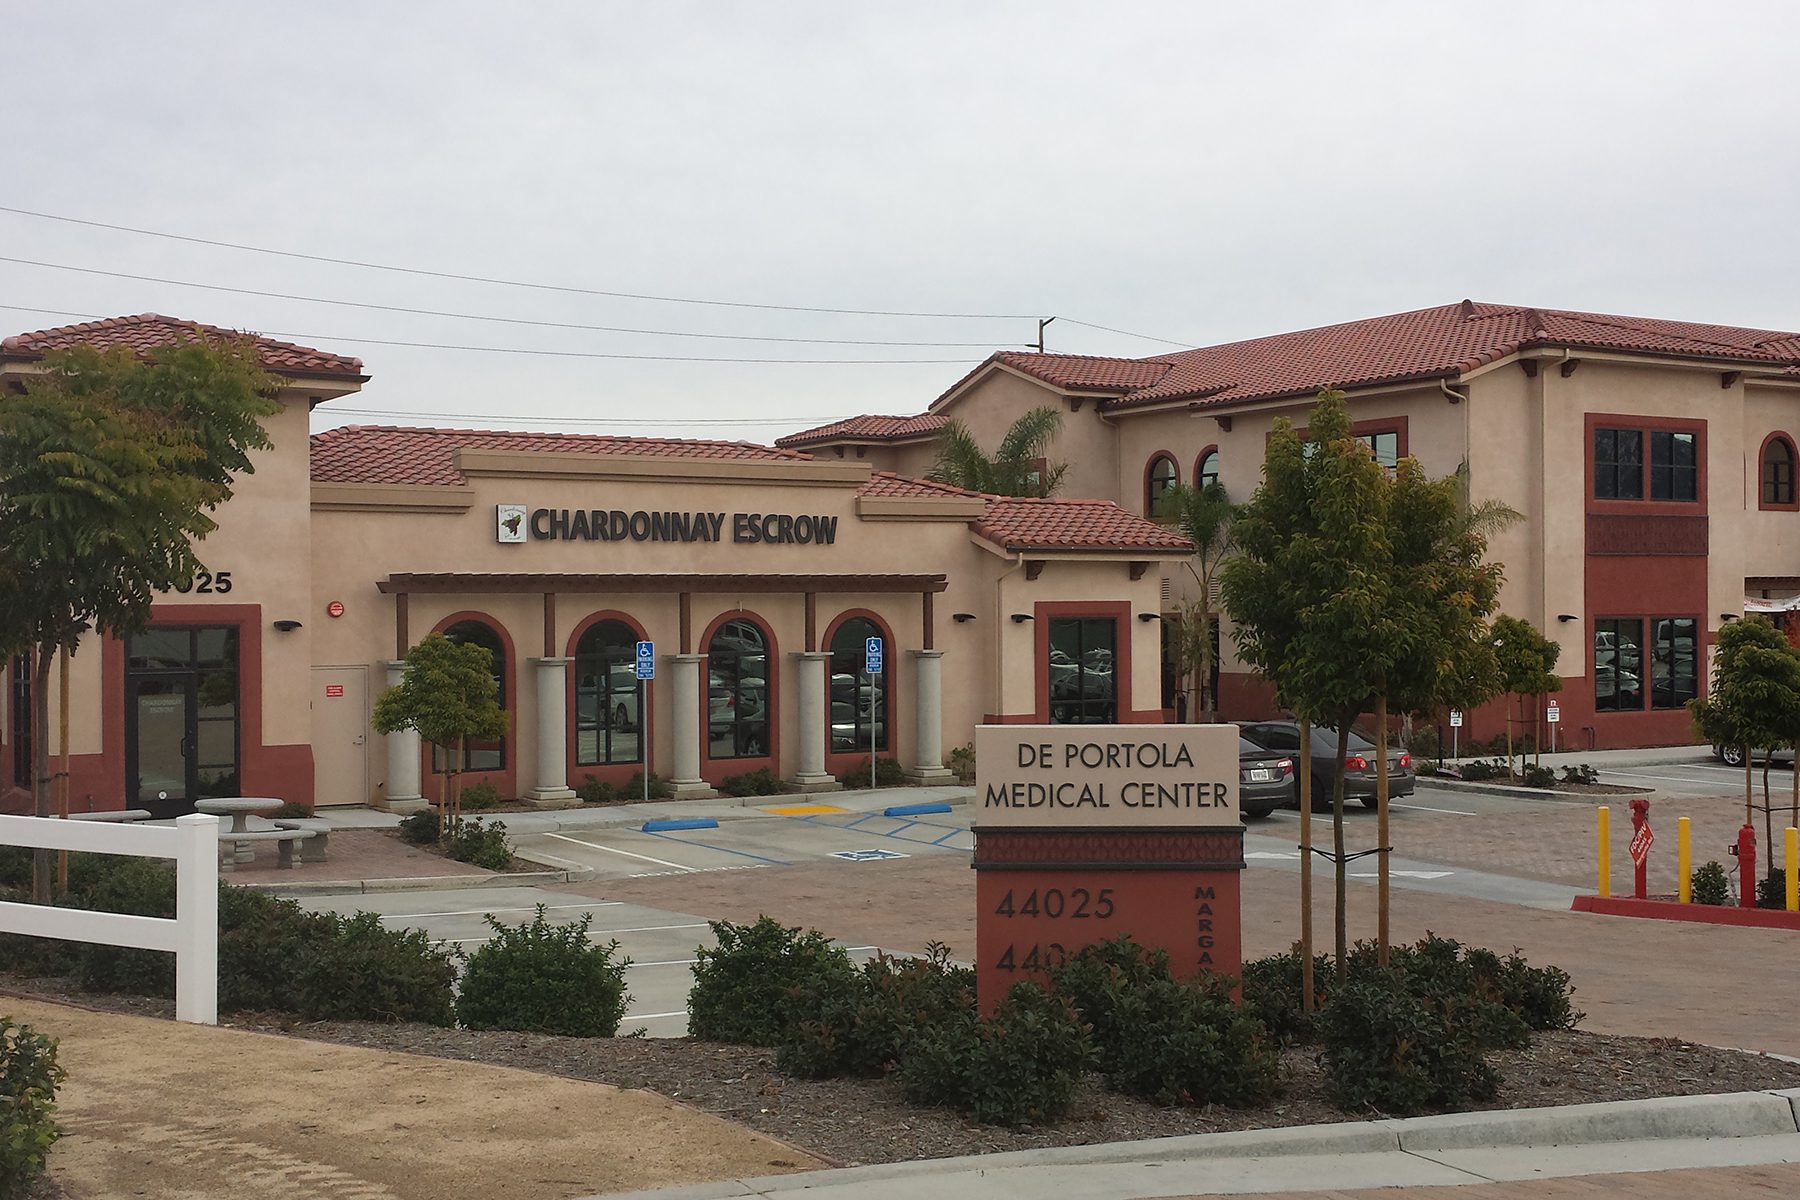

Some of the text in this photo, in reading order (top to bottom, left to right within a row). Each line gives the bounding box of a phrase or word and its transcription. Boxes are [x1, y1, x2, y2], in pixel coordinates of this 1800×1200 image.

[531, 509, 838, 544] CHARDONNAY ESCROW
[162, 572, 232, 593] 025
[1018, 742, 1194, 768] DE PORTOLA
[984, 782, 1229, 808] MEDICAL CENTER
[995, 888, 1114, 918] 44025
[995, 943, 1097, 972] 440
